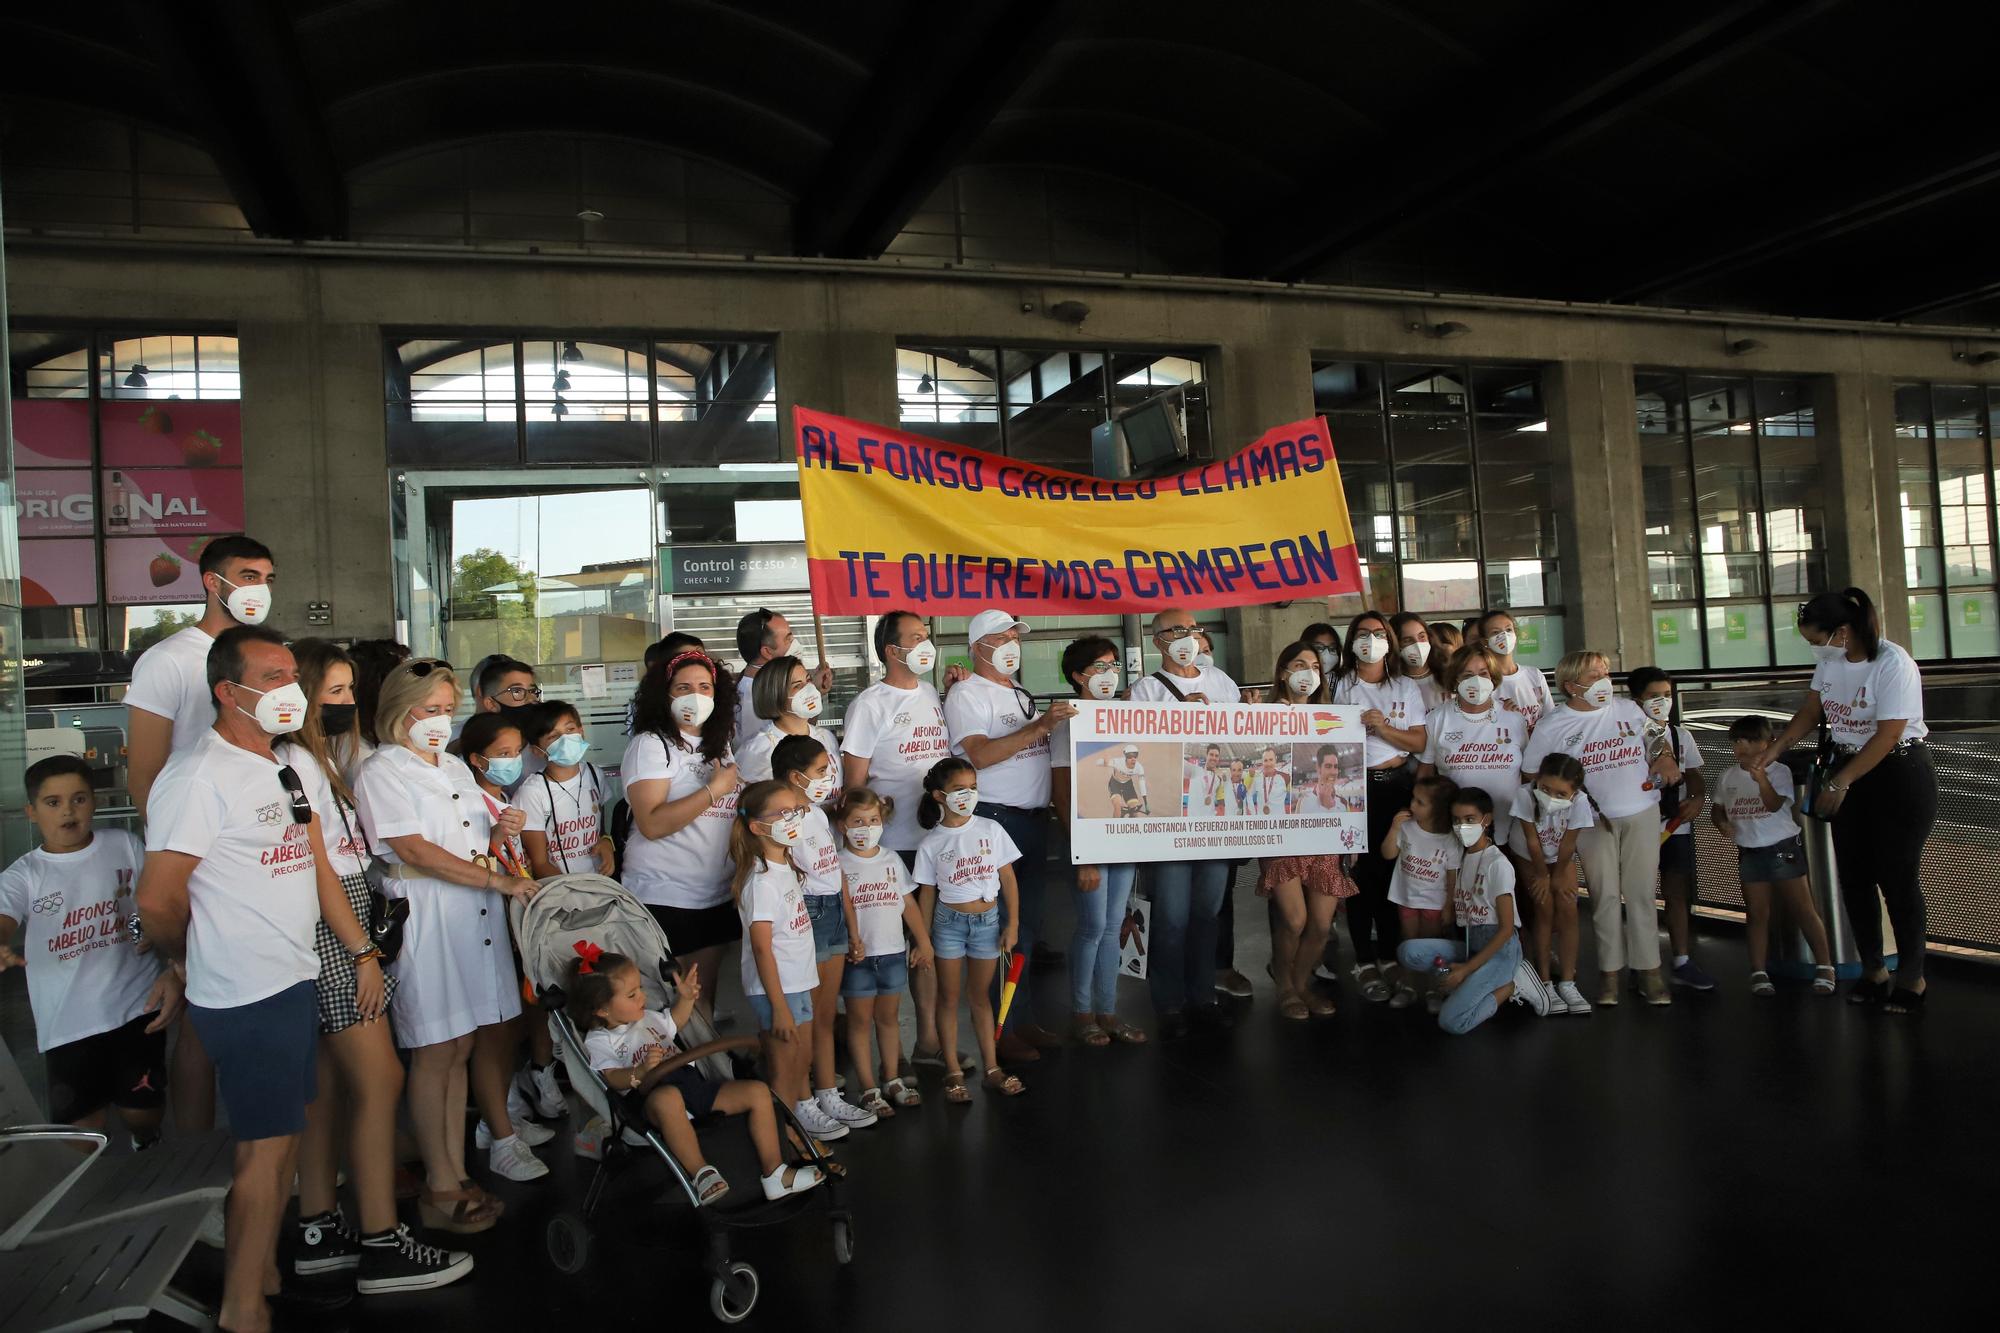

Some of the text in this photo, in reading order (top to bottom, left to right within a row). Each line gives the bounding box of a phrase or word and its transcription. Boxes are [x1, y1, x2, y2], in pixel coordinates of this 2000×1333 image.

[802, 425, 983, 492] ALFONSO
[683, 556, 798, 572] Control acceso 2
[839, 530, 1338, 602] TE QUEREMOS CAMPEON
[684, 576, 722, 584] CHECK-IN
[1095, 707, 1309, 736] ENHORABUENA CAMPEÓN
[912, 726, 942, 738] ALFONSO
[898, 740, 930, 754] CABELLO
[1458, 743, 1498, 752] ALFONSO
[1583, 738, 1624, 754] ALFONSO
[1610, 746, 1642, 760] LLAMAS
[1444, 754, 1514, 764] CABELLO LLAMAS
[256, 805, 270, 814] TOKYO
[1105, 818, 1342, 834] TU LUCHA, CONSTANCIA Y ESFUERZO HAN TENIDO LA MEJOR RECOMPENSA
[1174, 835, 1283, 848] ESTAMOS MUY ORGULLOSOS DE TI
[260, 841, 306, 866] CABELLO
[956, 856, 982, 869] ALFONSO
[270, 862, 306, 878] ¡RECORD
[1416, 866, 1439, 879] LLAMAS
[856, 882, 888, 894] ALFONSO
[48, 891, 62, 900] 2020
[62, 900, 120, 930] ALFONSO
[48, 925, 95, 953] CABELLO
[59, 945, 90, 961] RECORD
[92, 940, 110, 950] DEL
